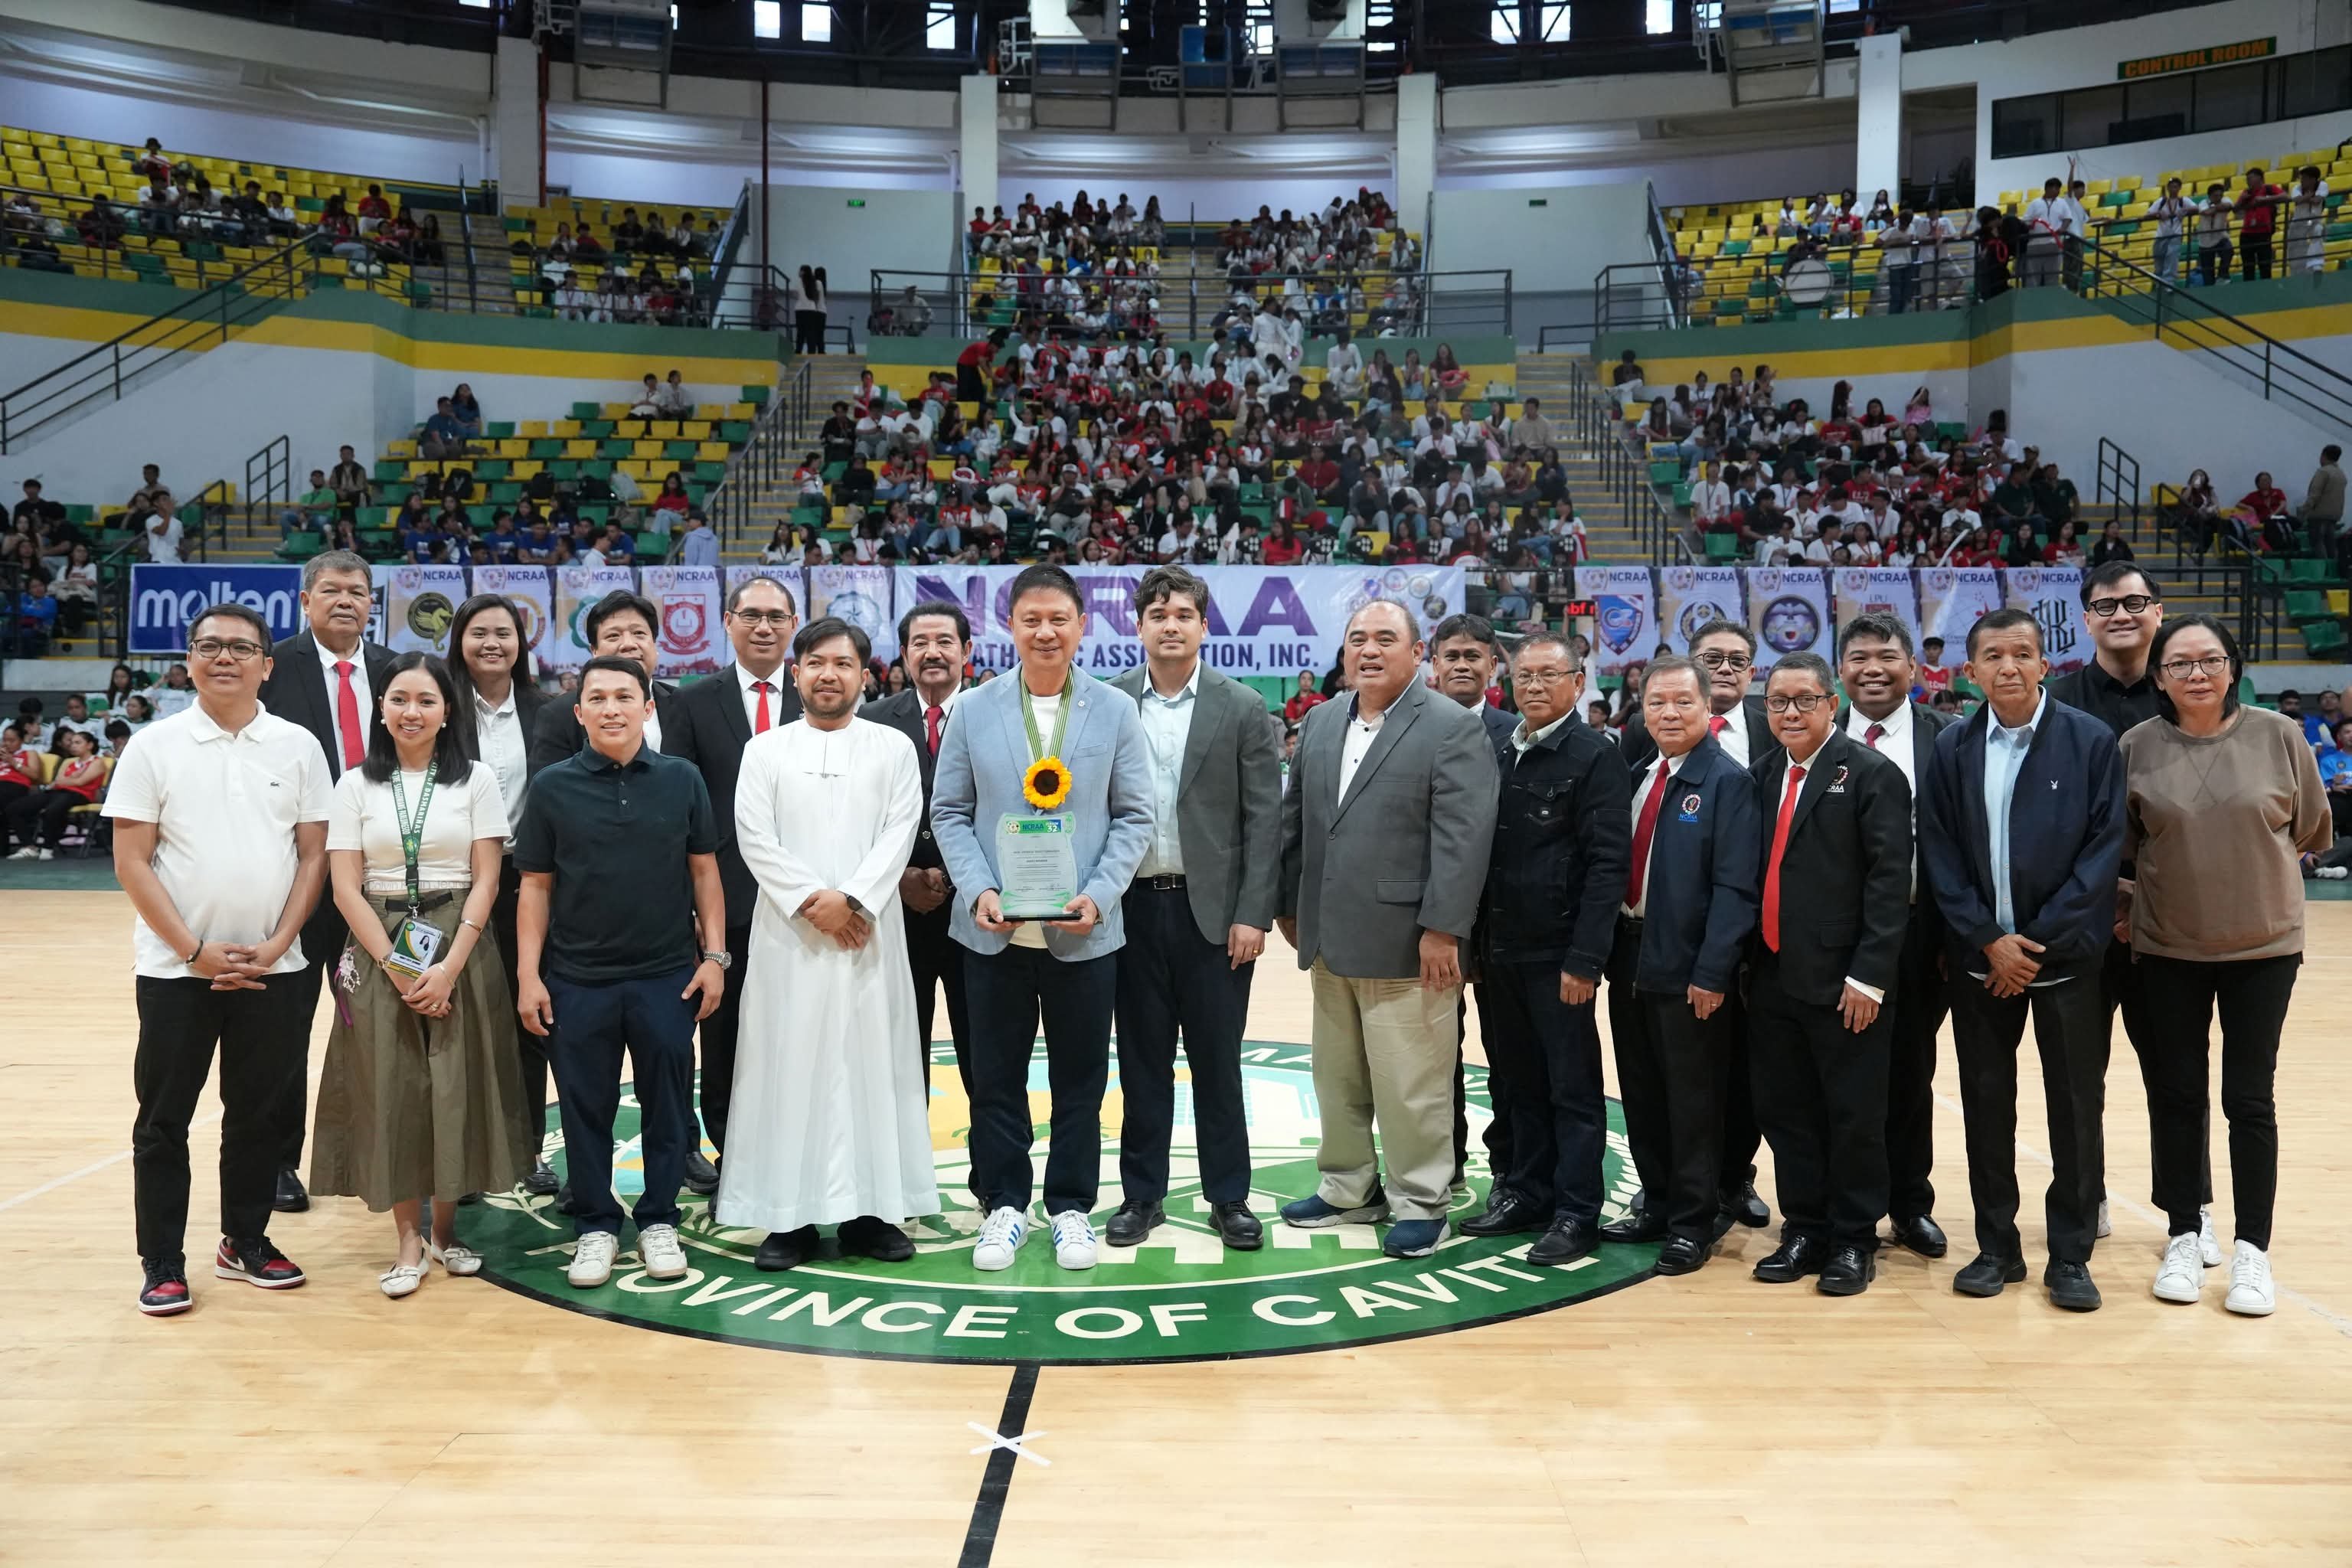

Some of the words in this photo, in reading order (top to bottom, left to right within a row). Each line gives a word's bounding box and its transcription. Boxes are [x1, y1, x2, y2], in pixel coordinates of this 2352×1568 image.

[2125, 52, 2207, 77] CONTROL
[2212, 40, 2269, 62] ROOM
[423, 570, 462, 581] NCRAA
[508, 570, 546, 581] NCRAA
[592, 570, 630, 581] NCRAA
[677, 570, 715, 581] NCRAA
[761, 570, 802, 581] NCRAA
[845, 570, 886, 580] NCRAA
[1609, 571, 1648, 582] NCRAA
[1696, 571, 1735, 582] NCRAA
[1782, 573, 1821, 583] NCRAA
[1869, 573, 1909, 583] NCRAA
[1955, 573, 1994, 583] NCRAA
[2041, 573, 2081, 583] NCRAA
[1269, 643, 1318, 667] INC.
[1047, 825, 1058, 833] 32
[1054, 1302, 1207, 1340] OF
